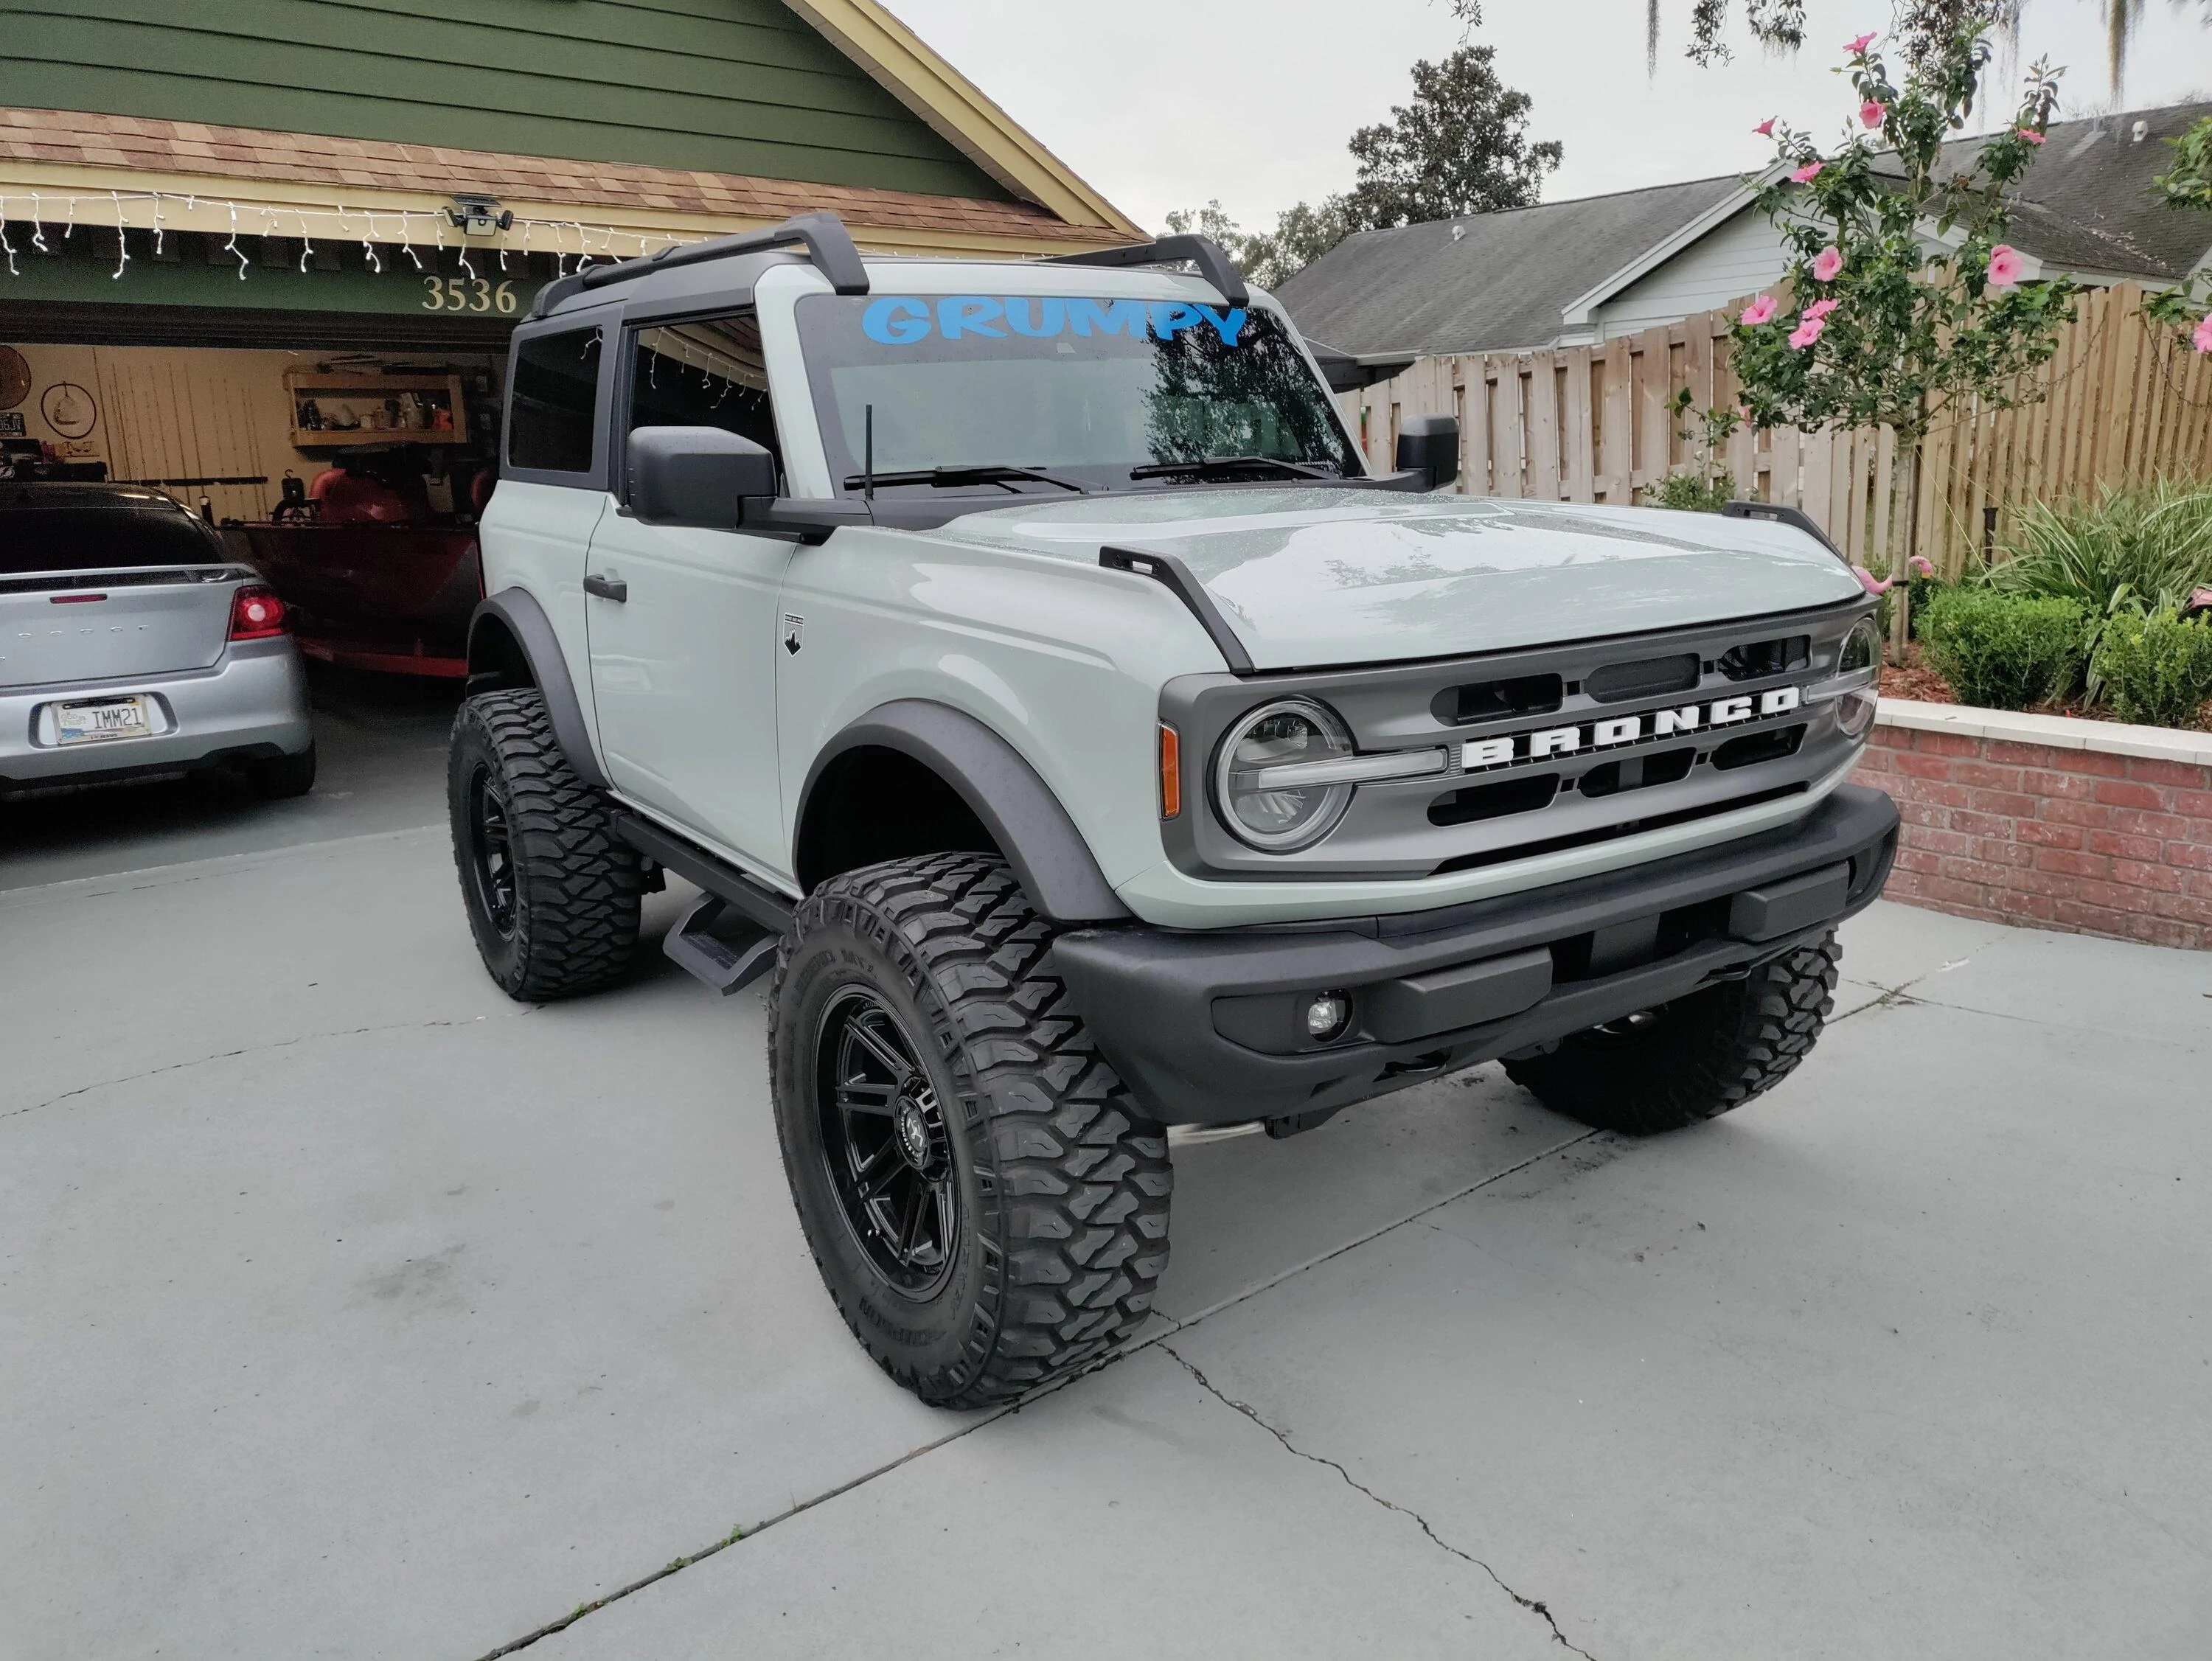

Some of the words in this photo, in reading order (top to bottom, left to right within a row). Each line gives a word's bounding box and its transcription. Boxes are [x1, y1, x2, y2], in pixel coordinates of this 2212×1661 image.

[422, 276, 516, 313] 3536
[861, 296, 1248, 347] GRUMPY
[18, 624, 149, 639] DODGE
[92, 708, 142, 729] IMM21
[1461, 686, 1800, 768] BRONCO
